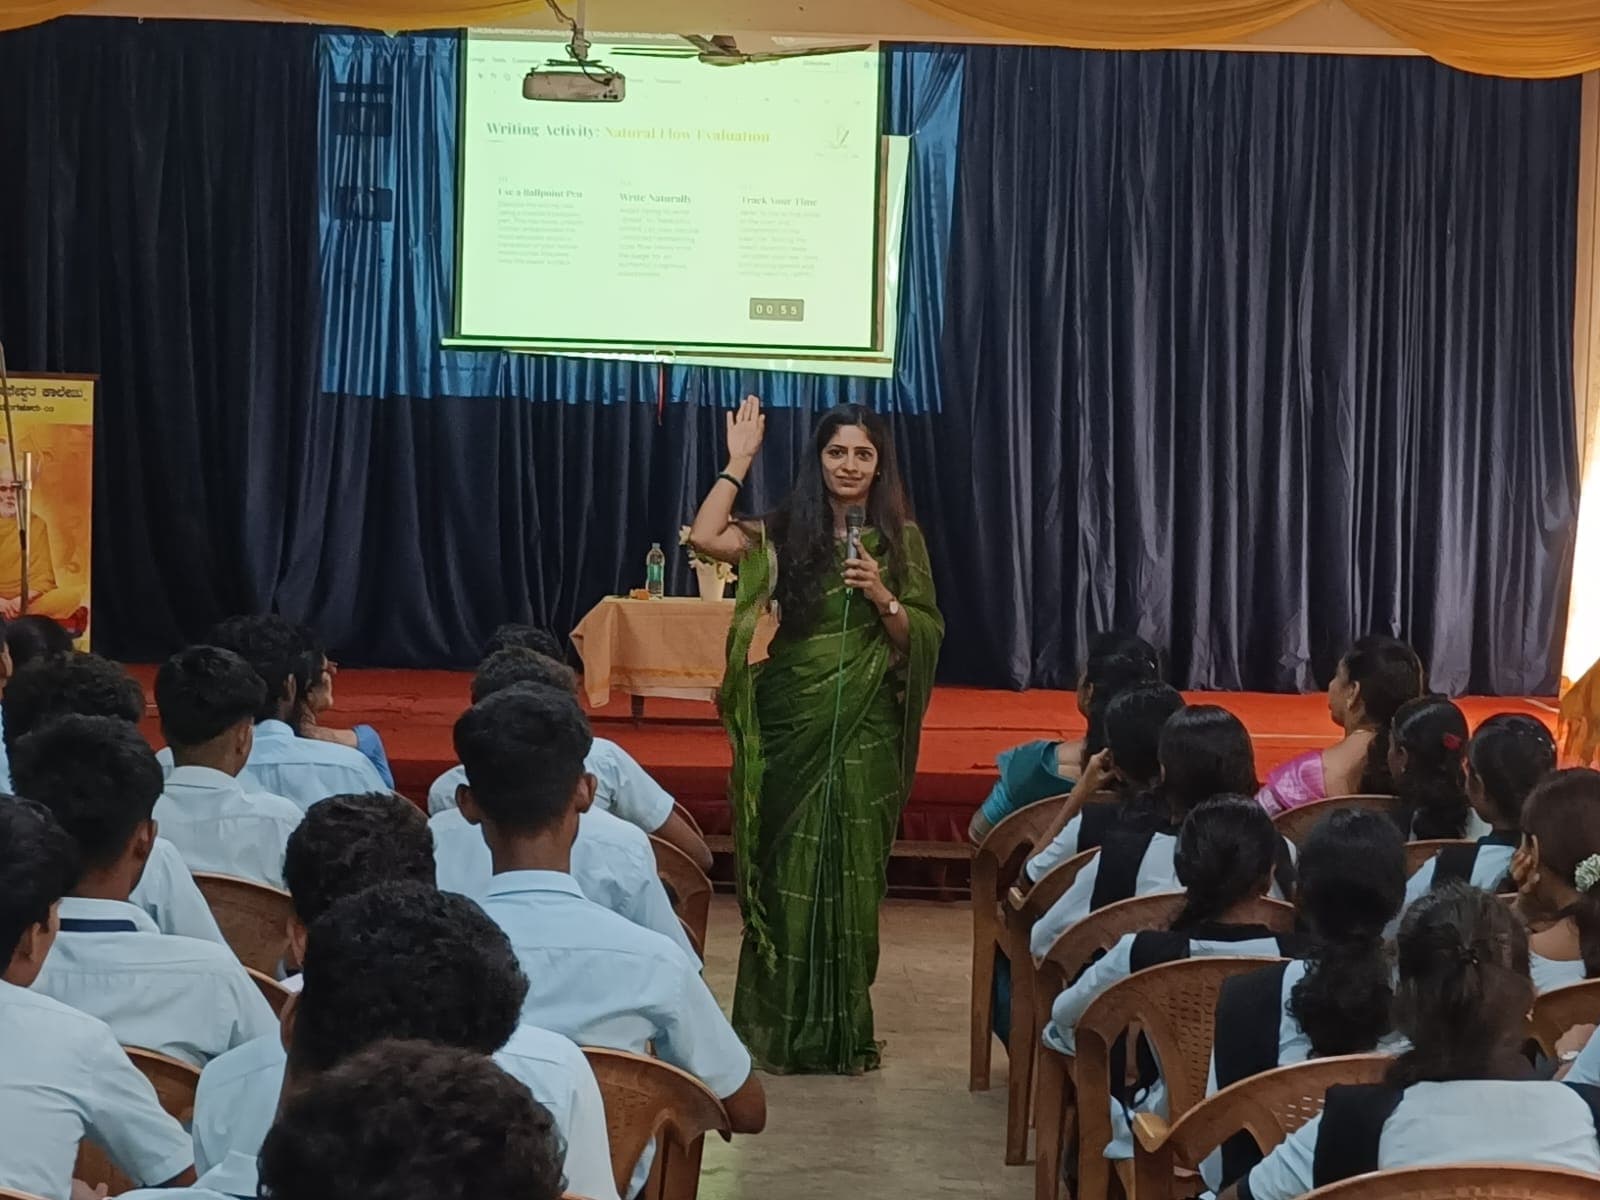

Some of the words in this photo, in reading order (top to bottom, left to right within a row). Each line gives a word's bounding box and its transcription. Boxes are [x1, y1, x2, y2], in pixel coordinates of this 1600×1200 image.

[486, 121, 540, 138] Writing
[545, 123, 601, 140] Activity:
[604, 126, 656, 140] Natural
[659, 127, 691, 142] Flow
[696, 128, 771, 144] Evaluation
[523, 187, 564, 200] Ballpoint
[566, 189, 584, 199] Pen
[619, 192, 646, 203] Write
[648, 193, 692, 205] Naturally
[740, 195, 768, 206] Track
[769, 196, 792, 207] Your
[794, 196, 818, 208] Time
